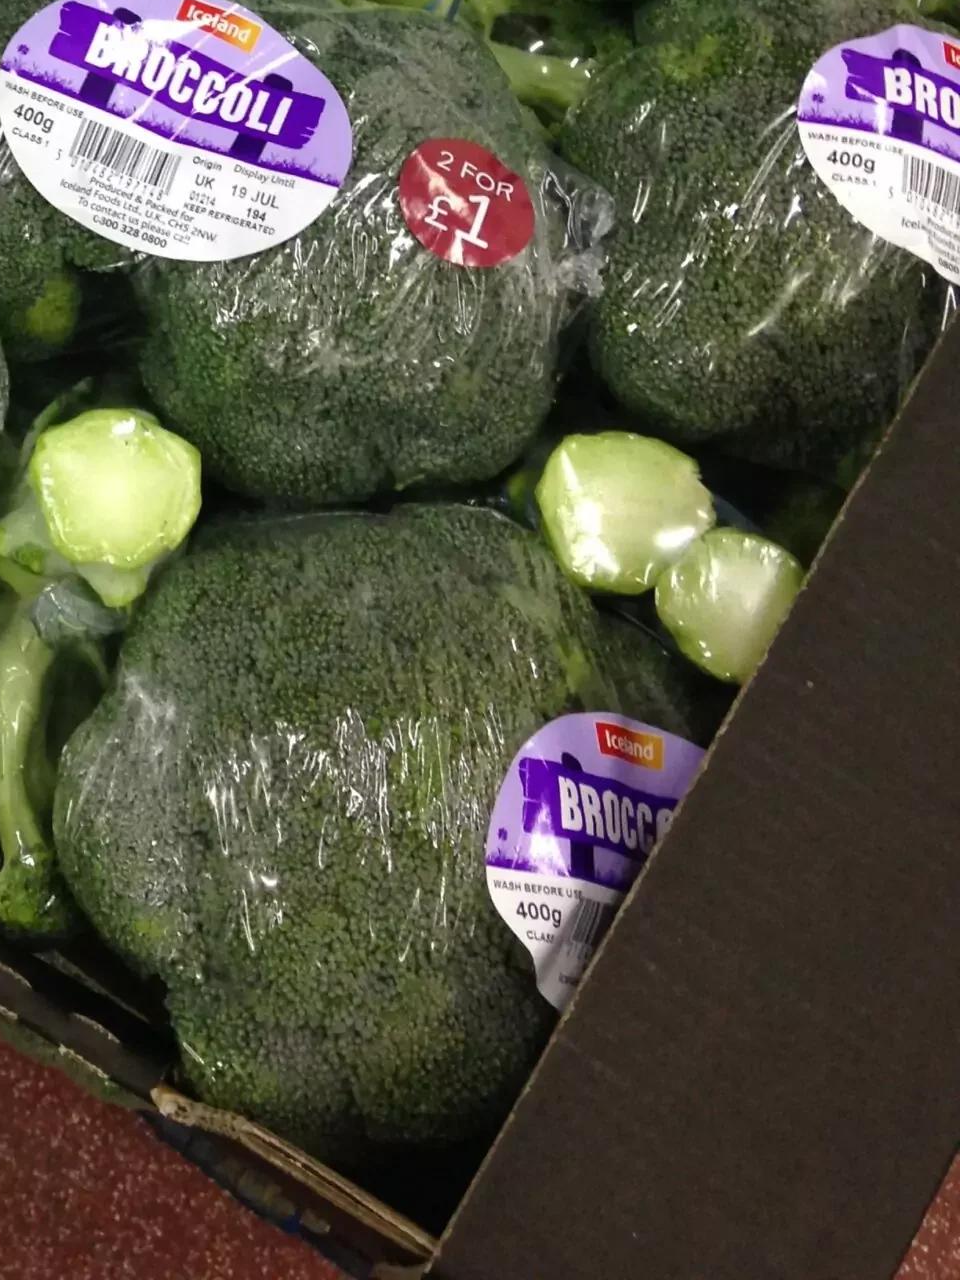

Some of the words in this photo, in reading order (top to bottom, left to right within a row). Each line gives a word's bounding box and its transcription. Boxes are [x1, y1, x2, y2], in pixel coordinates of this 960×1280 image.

[187, 5, 251, 42] Iceland
[85, 22, 293, 135] BROCCOLI
[14, 104, 54, 133] 400g
[30, 91, 65, 112] BEFORE
[67, 107, 84, 119] USE
[12, 127, 43, 145] CLASS
[808, 132, 838, 142] WASH
[841, 136, 880, 150] BEFORE
[192, 156, 222, 171] Origin
[233, 164, 270, 184] Display
[271, 175, 296, 189] Until
[437, 151, 453, 171] 2
[460, 162, 514, 201] FOR
[827, 150, 875, 173] 400g
[60, 179, 93, 197] Iceland
[93, 189, 121, 207] Foods
[195, 174, 215, 190] UK
[231, 184, 247, 199] 19
[251, 191, 279, 209] JUL
[831, 173, 868, 185] CLASS
[89, 176, 134, 201] Produced
[145, 199, 179, 218] Packed
[180, 211, 195, 223] for
[78, 196, 89, 207] To
[90, 203, 127, 222] contact
[140, 221, 171, 237] please
[184, 202, 207, 214] KEEP
[208, 210, 275, 235] REFRIGERATED
[247, 208, 267, 222] 194
[424, 195, 489, 249] £1
[120, 224, 140, 238] 328
[141, 232, 167, 248] 0800
[605, 729, 654, 761] Iceland
[493, 880, 522, 891] WASH
[524, 883, 562, 897] BEFORE
[516, 902, 562, 928] 400g
